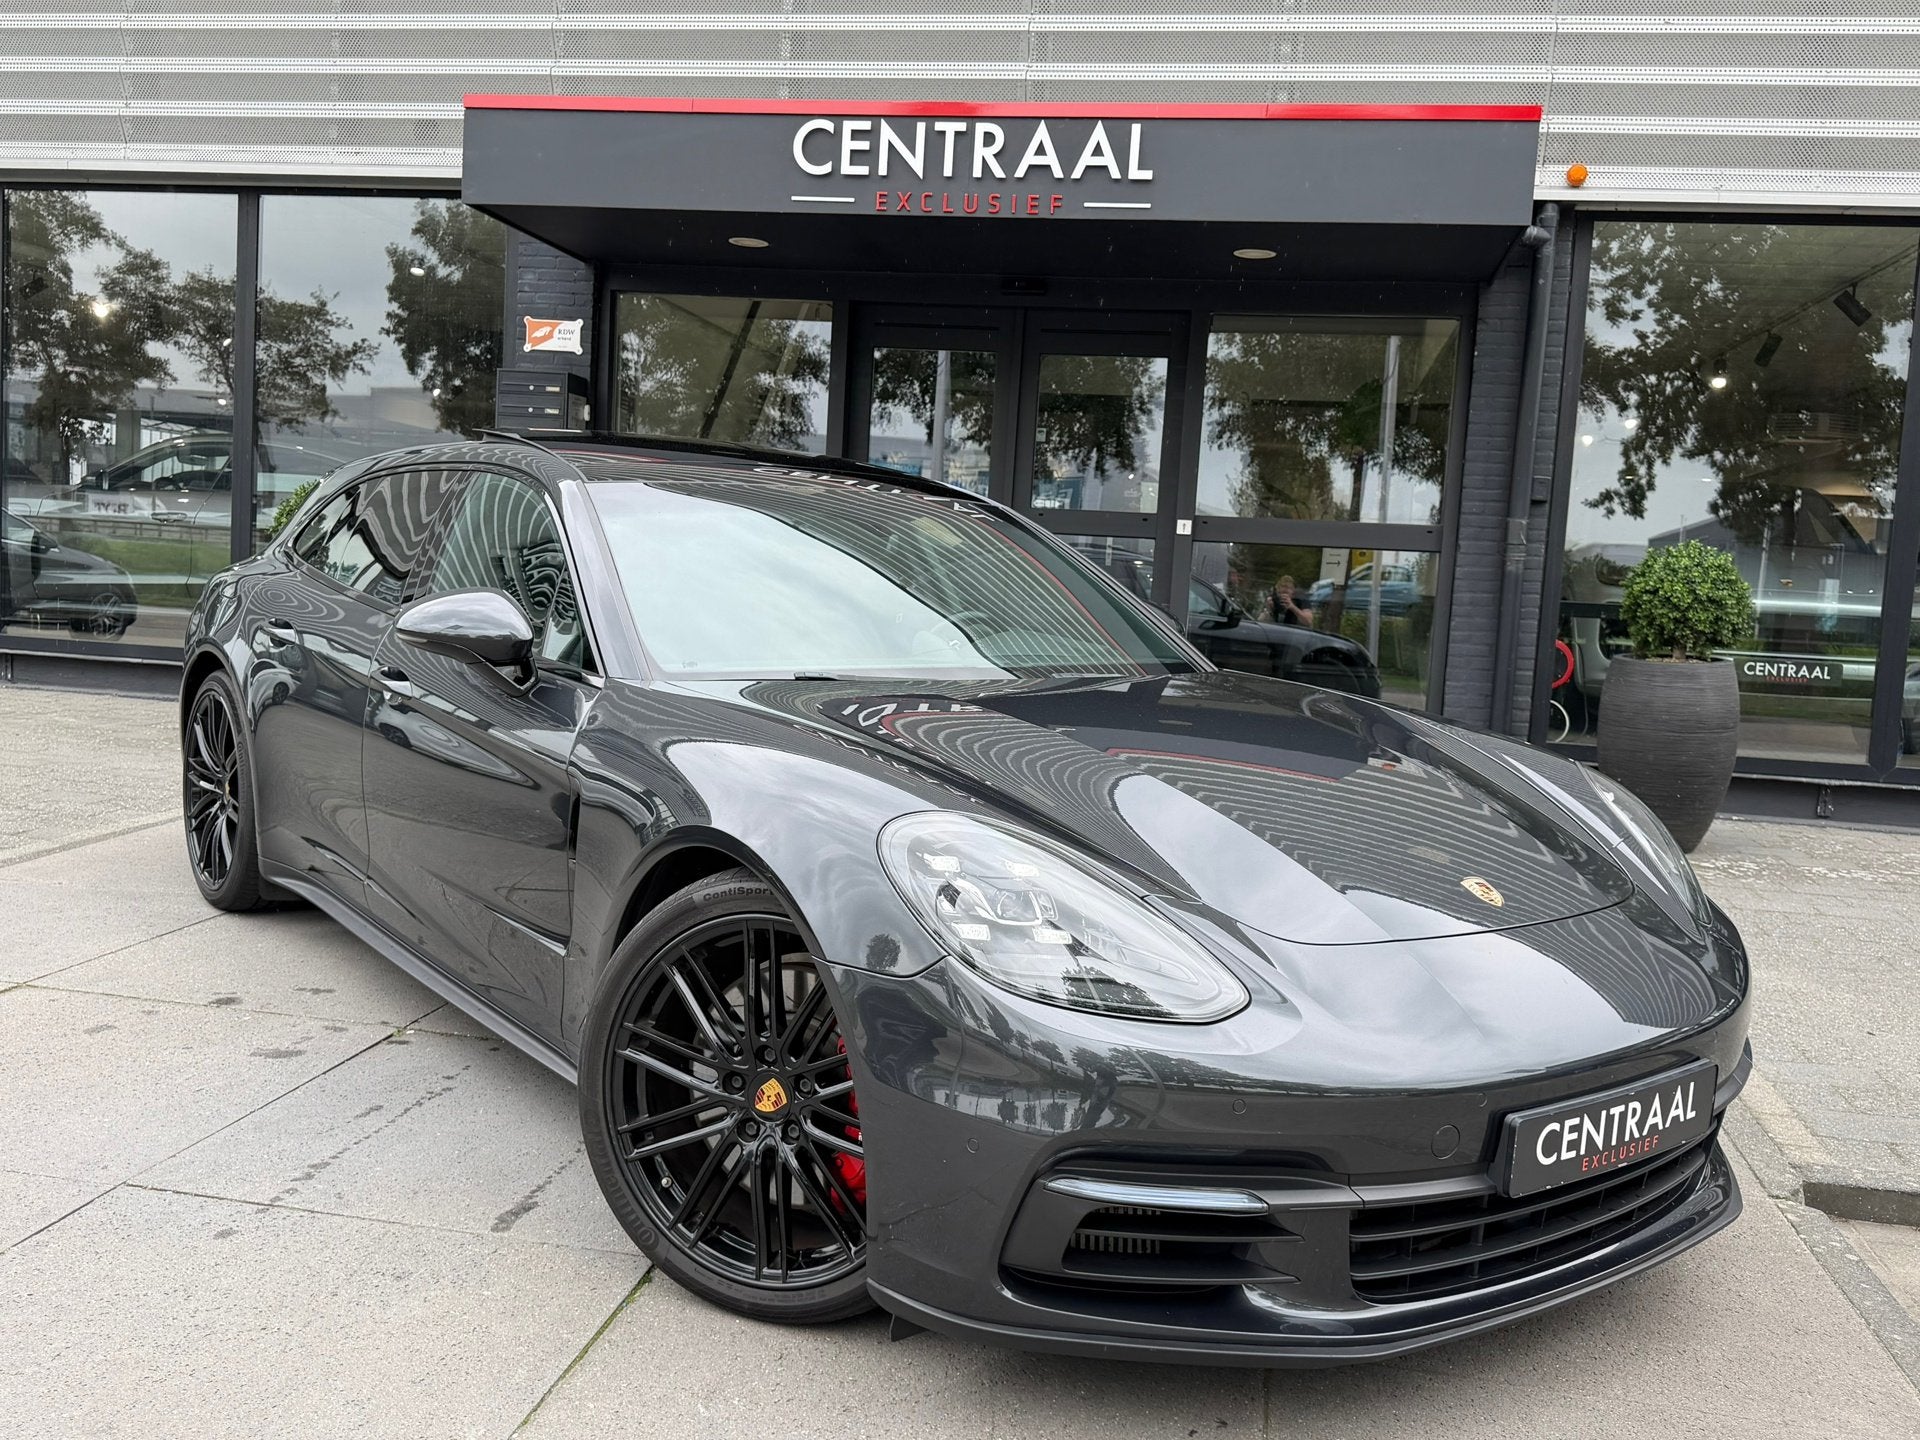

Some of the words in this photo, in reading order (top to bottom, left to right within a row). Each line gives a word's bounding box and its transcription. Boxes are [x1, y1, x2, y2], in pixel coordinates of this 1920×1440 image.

[792, 118, 1154, 181] CENTRAAL
[875, 191, 1064, 215] EXCLUSIEF
[1743, 661, 1831, 680] CENTRAAL
[1536, 1081, 1697, 1166] CENTRAAL
[1581, 1134, 1660, 1172] EXCLUSIEF
